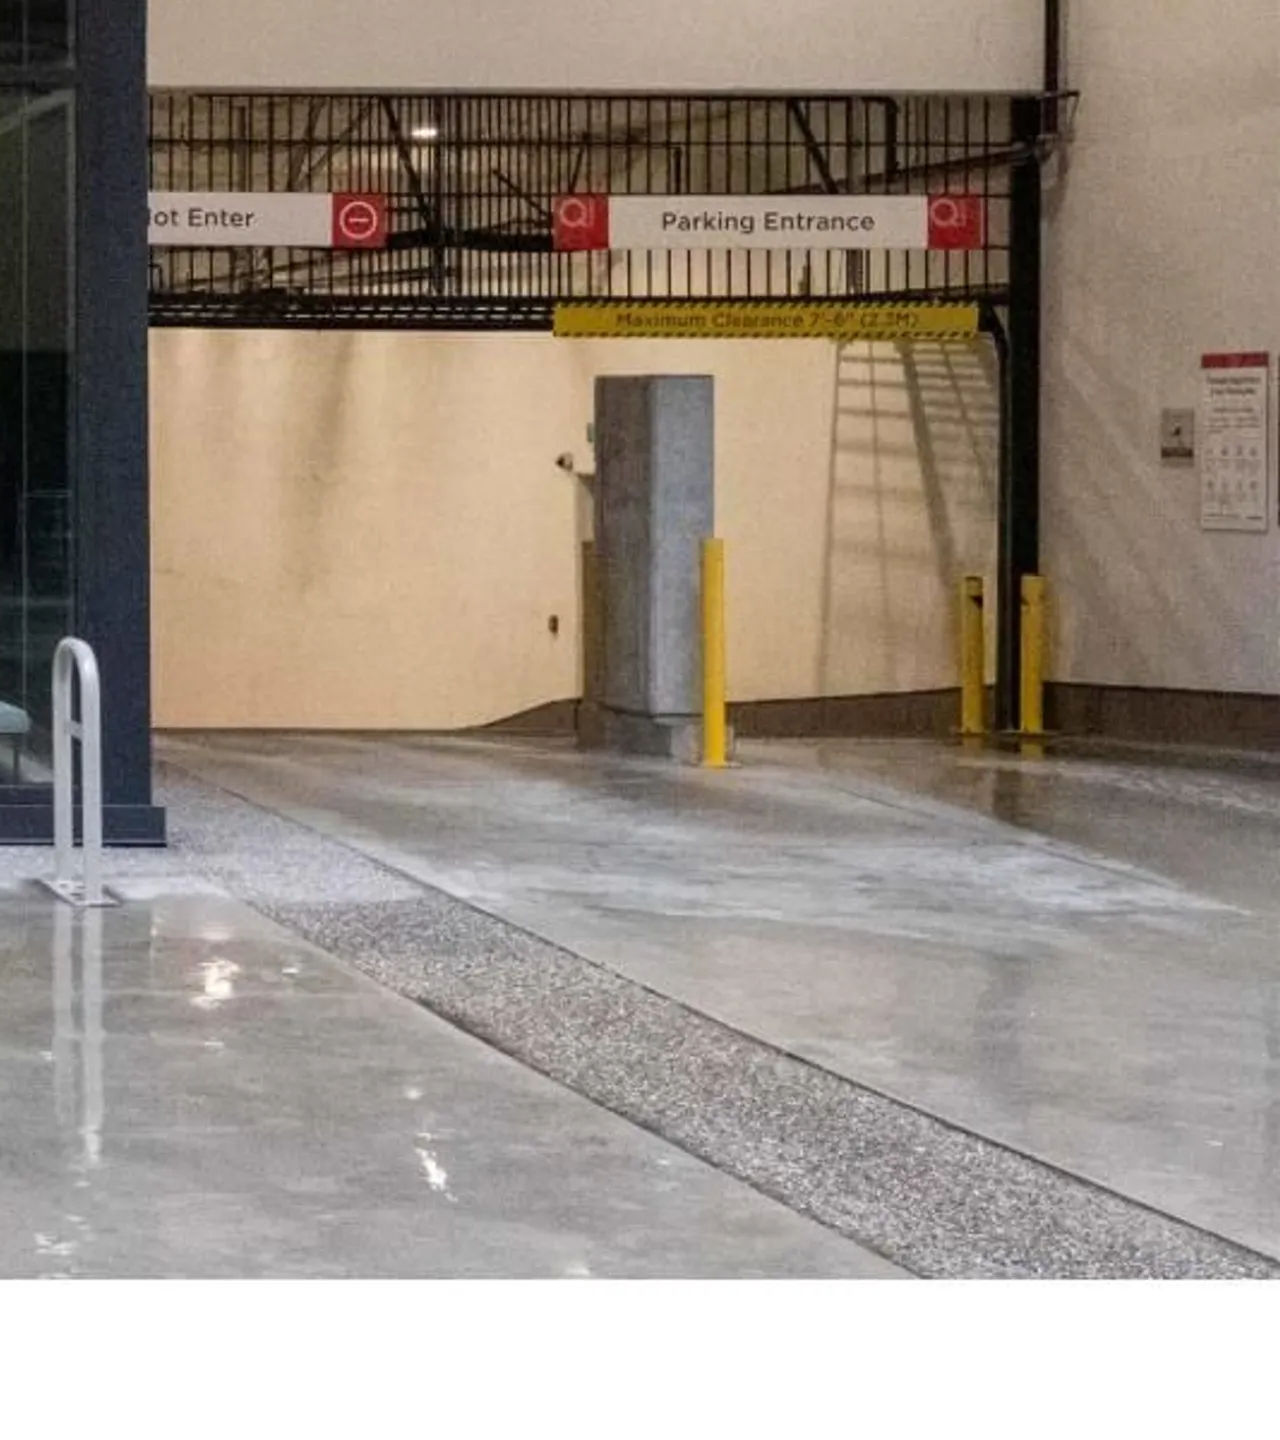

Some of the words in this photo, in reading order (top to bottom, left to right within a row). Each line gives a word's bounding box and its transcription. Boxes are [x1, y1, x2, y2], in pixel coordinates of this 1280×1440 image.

[148, 208, 179, 228] ot
[187, 208, 255, 228] Enter
[661, 211, 755, 234] Parking
[763, 211, 876, 231] Entrance
[616, 312, 707, 328] Maximum
[711, 312, 804, 328] Clearance
